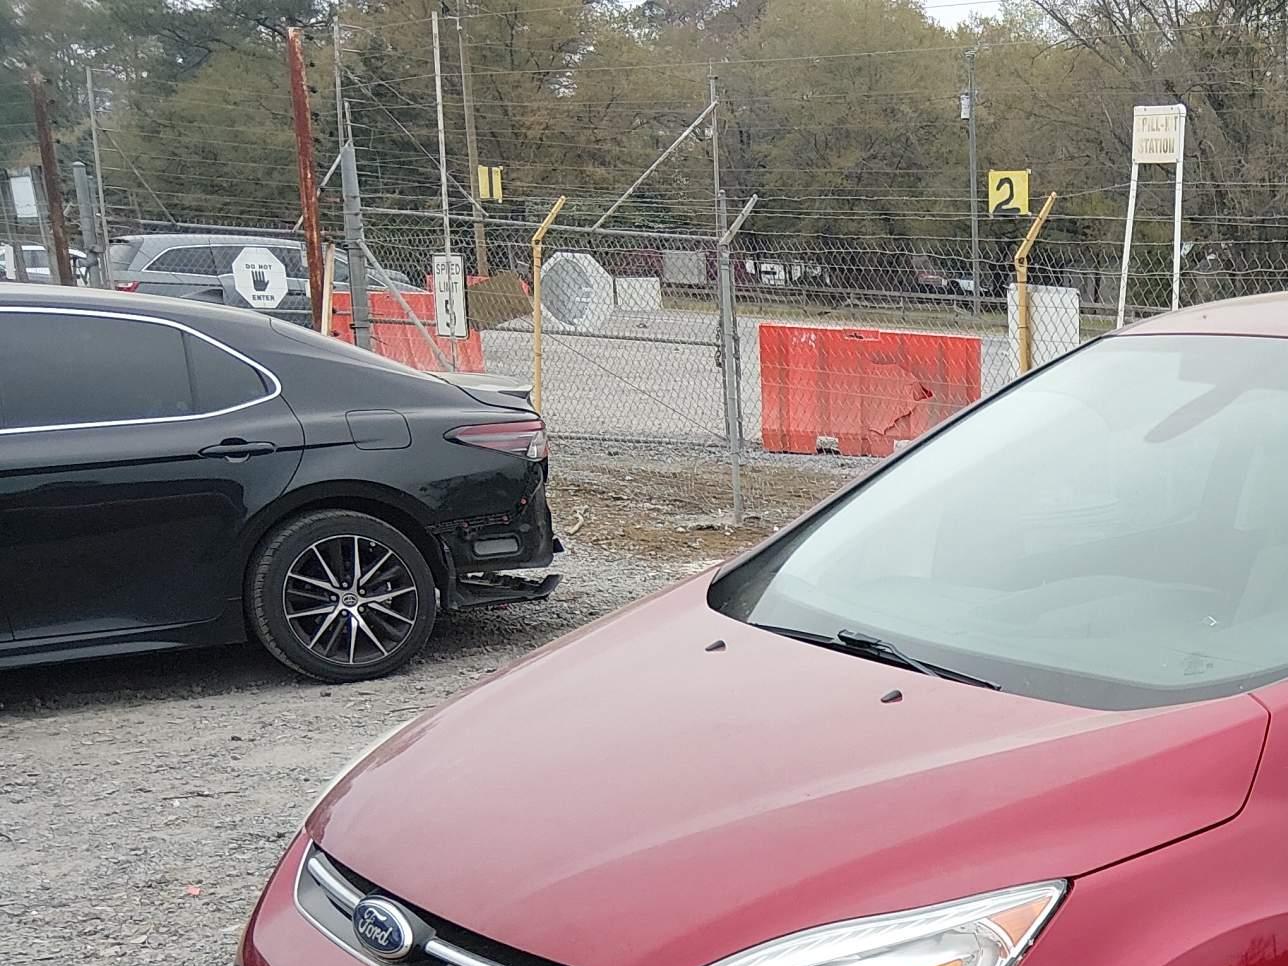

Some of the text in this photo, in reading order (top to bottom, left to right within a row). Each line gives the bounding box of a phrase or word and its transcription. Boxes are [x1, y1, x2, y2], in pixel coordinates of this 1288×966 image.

[1136, 115, 1178, 131] PILL-KT
[1138, 138, 1175, 154] STATION
[992, 177, 1021, 217] 2
[358, 907, 393, 946] Ford
